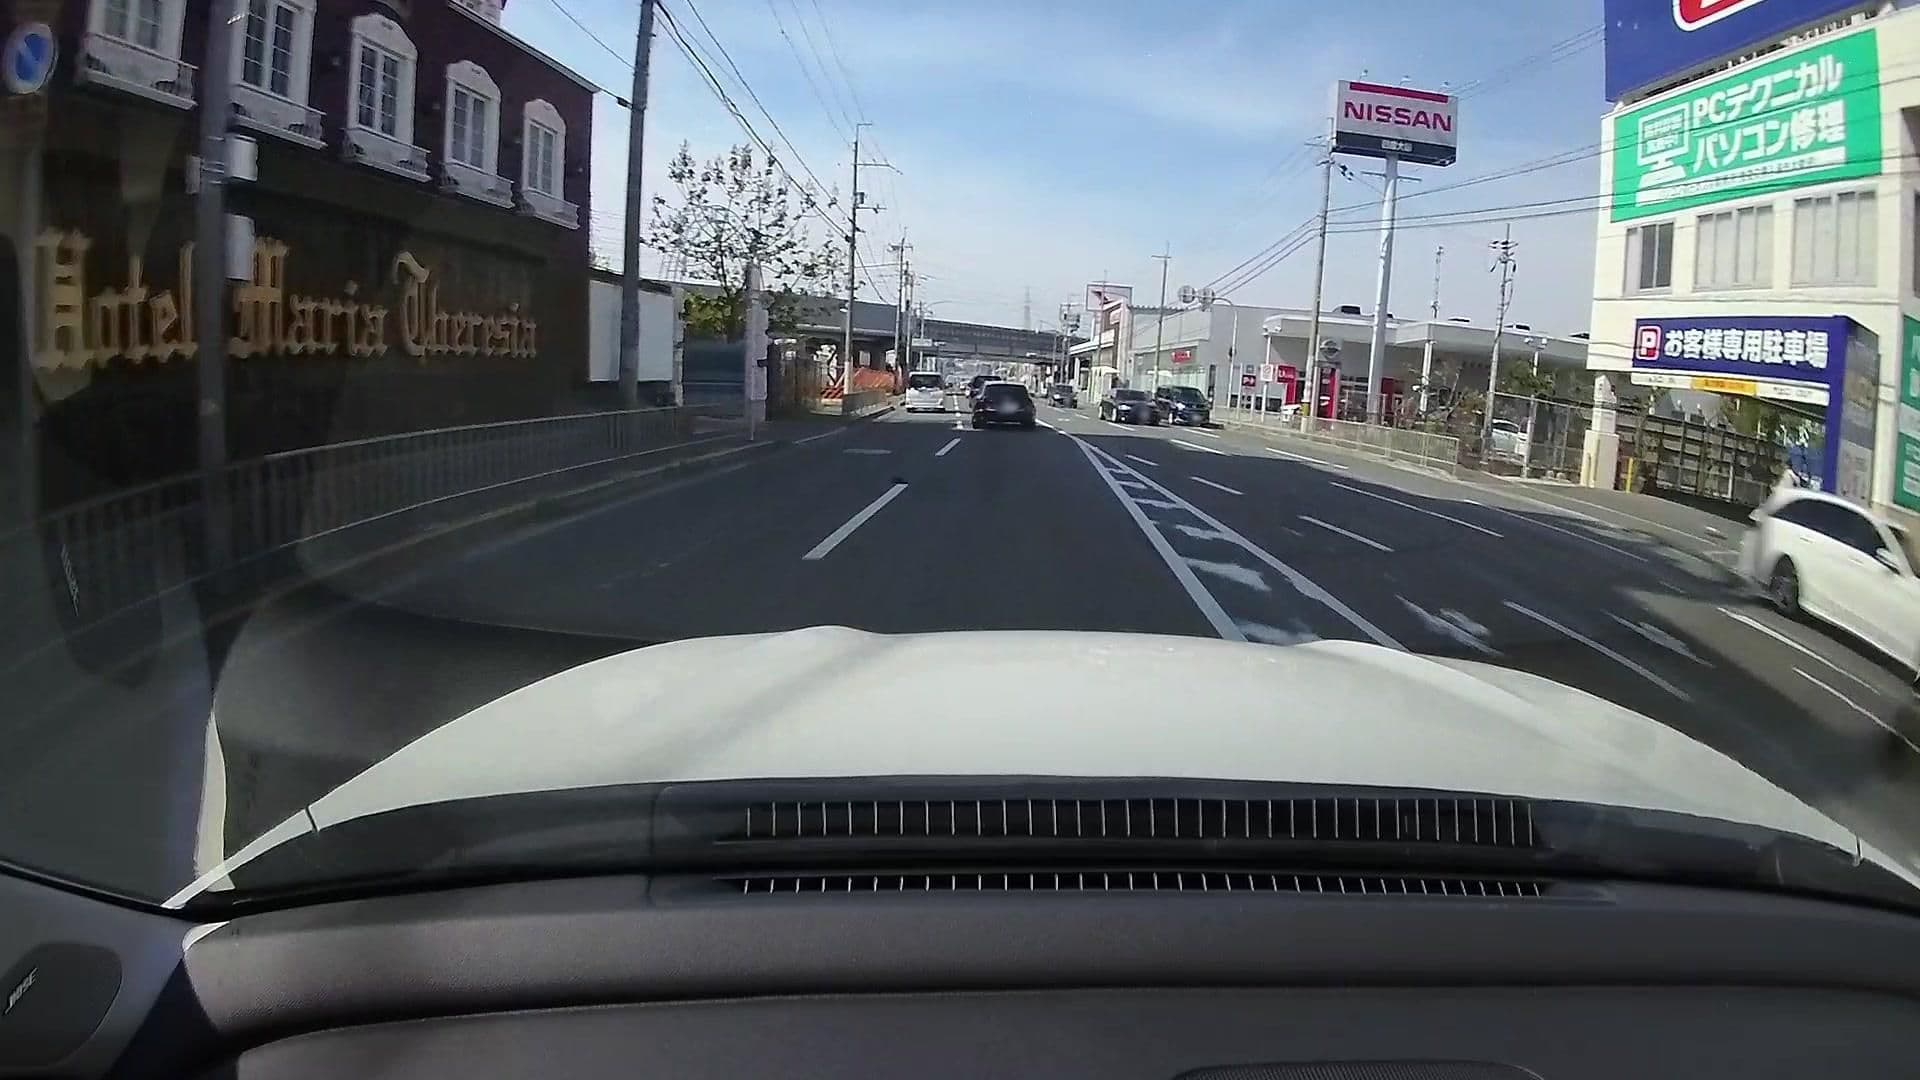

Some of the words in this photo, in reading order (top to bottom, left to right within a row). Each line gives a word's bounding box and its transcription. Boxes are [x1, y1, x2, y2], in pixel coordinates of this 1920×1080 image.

[1344, 101, 1452, 131] NISSAN
[1693, 54, 1844, 126] PCテクニカル
[1693, 99, 1847, 173] パソコン修理
[33, 229, 198, 369] Hotel
[226, 237, 388, 358] Maria
[394, 251, 537, 358] Theresia
[1664, 328, 1830, 369] お客様専用駐車場
